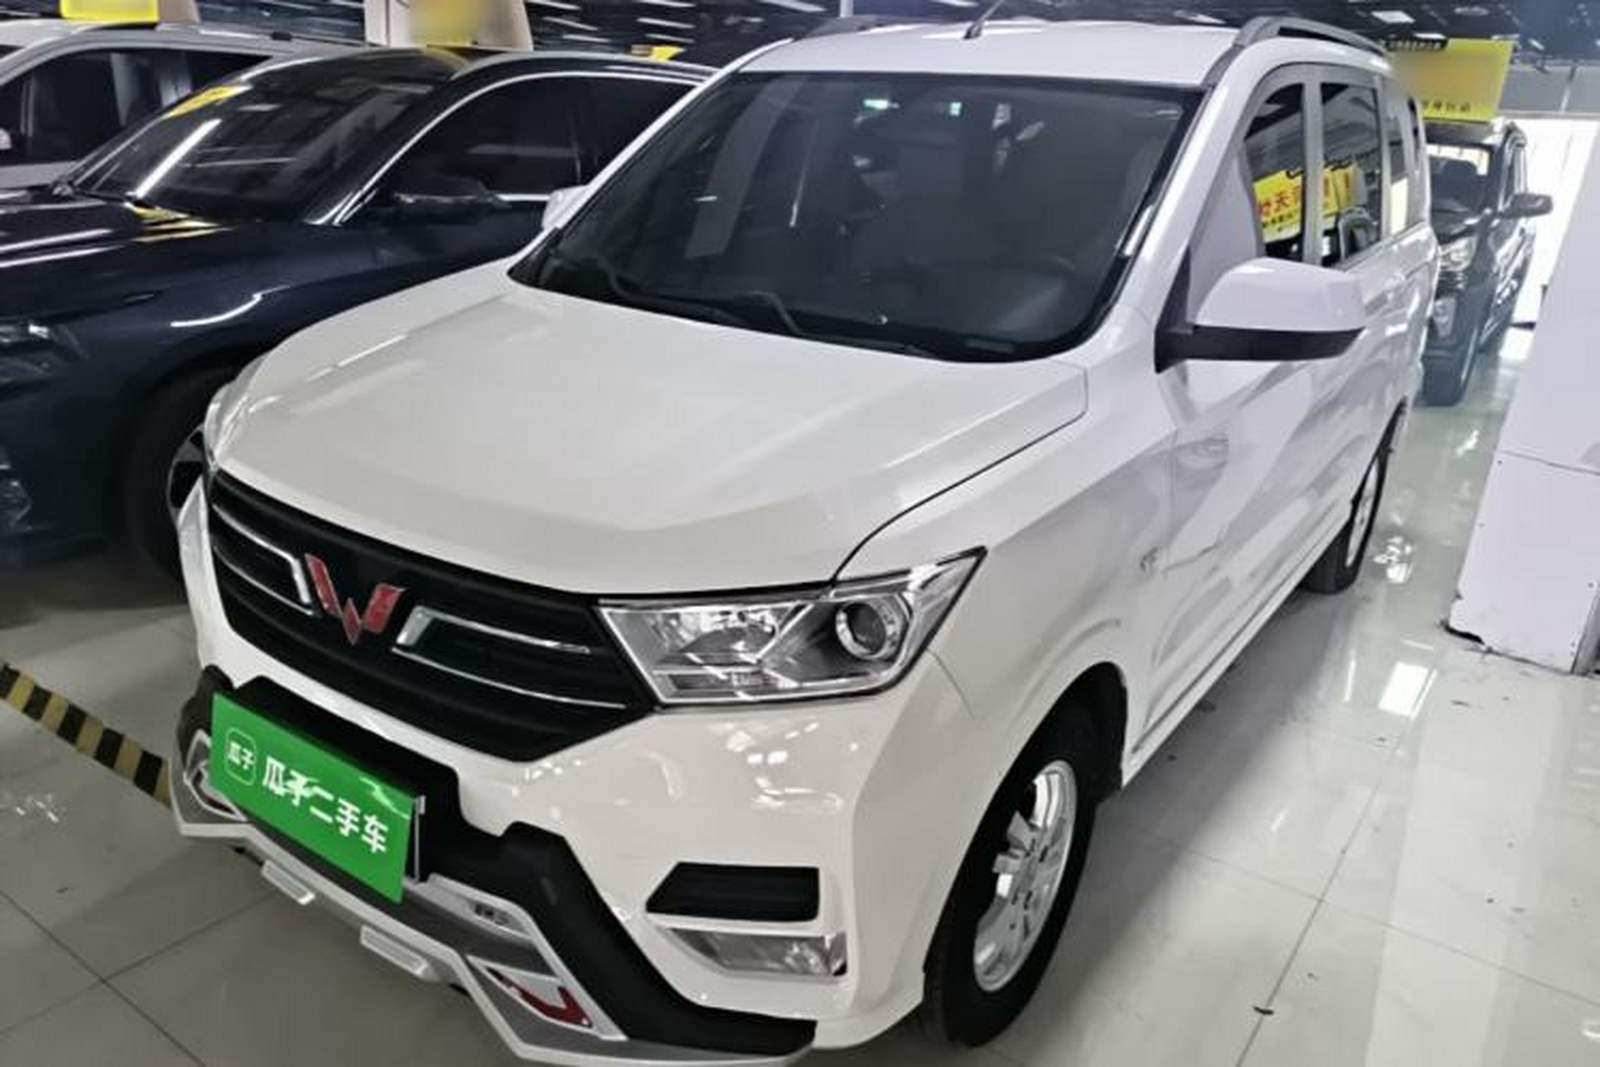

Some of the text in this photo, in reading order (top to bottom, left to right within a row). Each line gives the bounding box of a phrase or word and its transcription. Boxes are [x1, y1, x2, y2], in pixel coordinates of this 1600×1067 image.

[226, 741, 254, 770] 瓜子
[262, 755, 389, 854] 瓜子二手车
